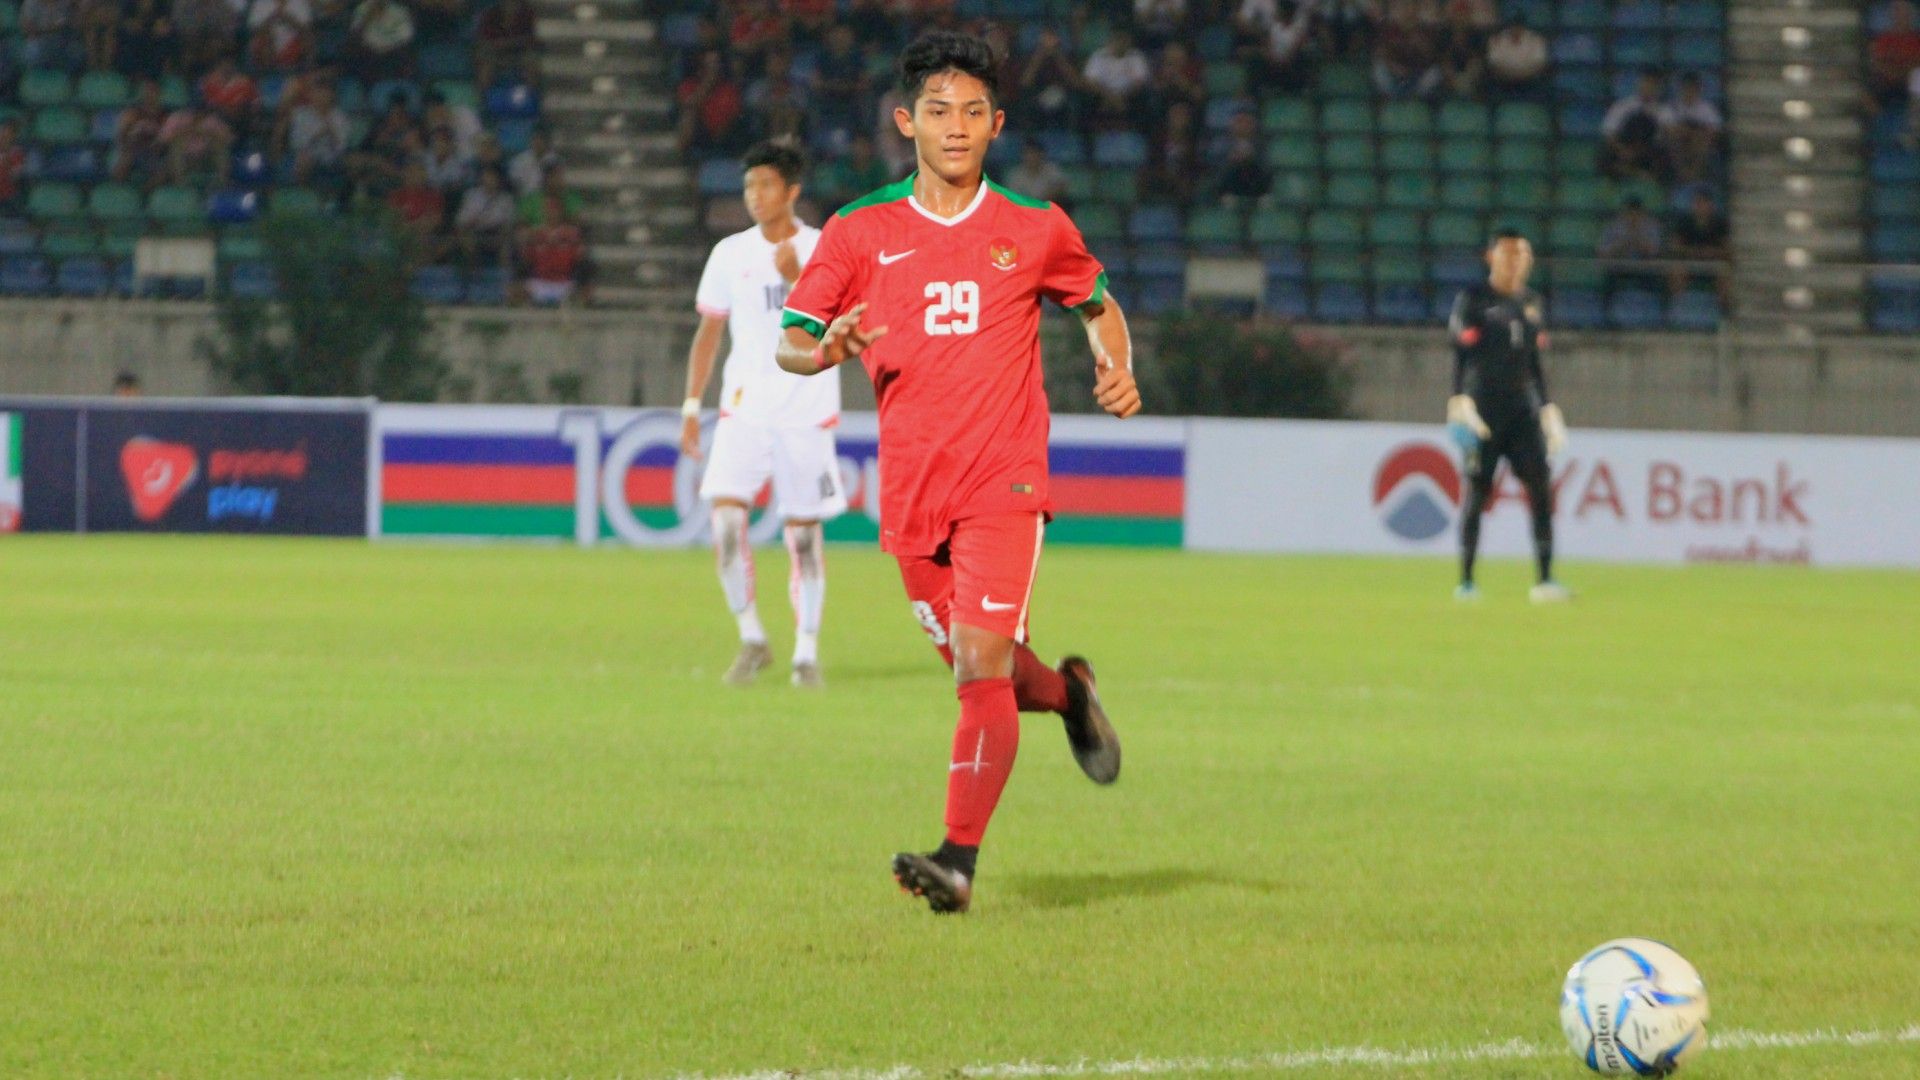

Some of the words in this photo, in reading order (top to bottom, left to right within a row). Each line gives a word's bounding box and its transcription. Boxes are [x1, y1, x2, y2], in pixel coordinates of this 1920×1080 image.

[924, 280, 979, 336] 29
[1648, 461, 1810, 524] Bank
[1597, 1003, 1621, 1074] molten
